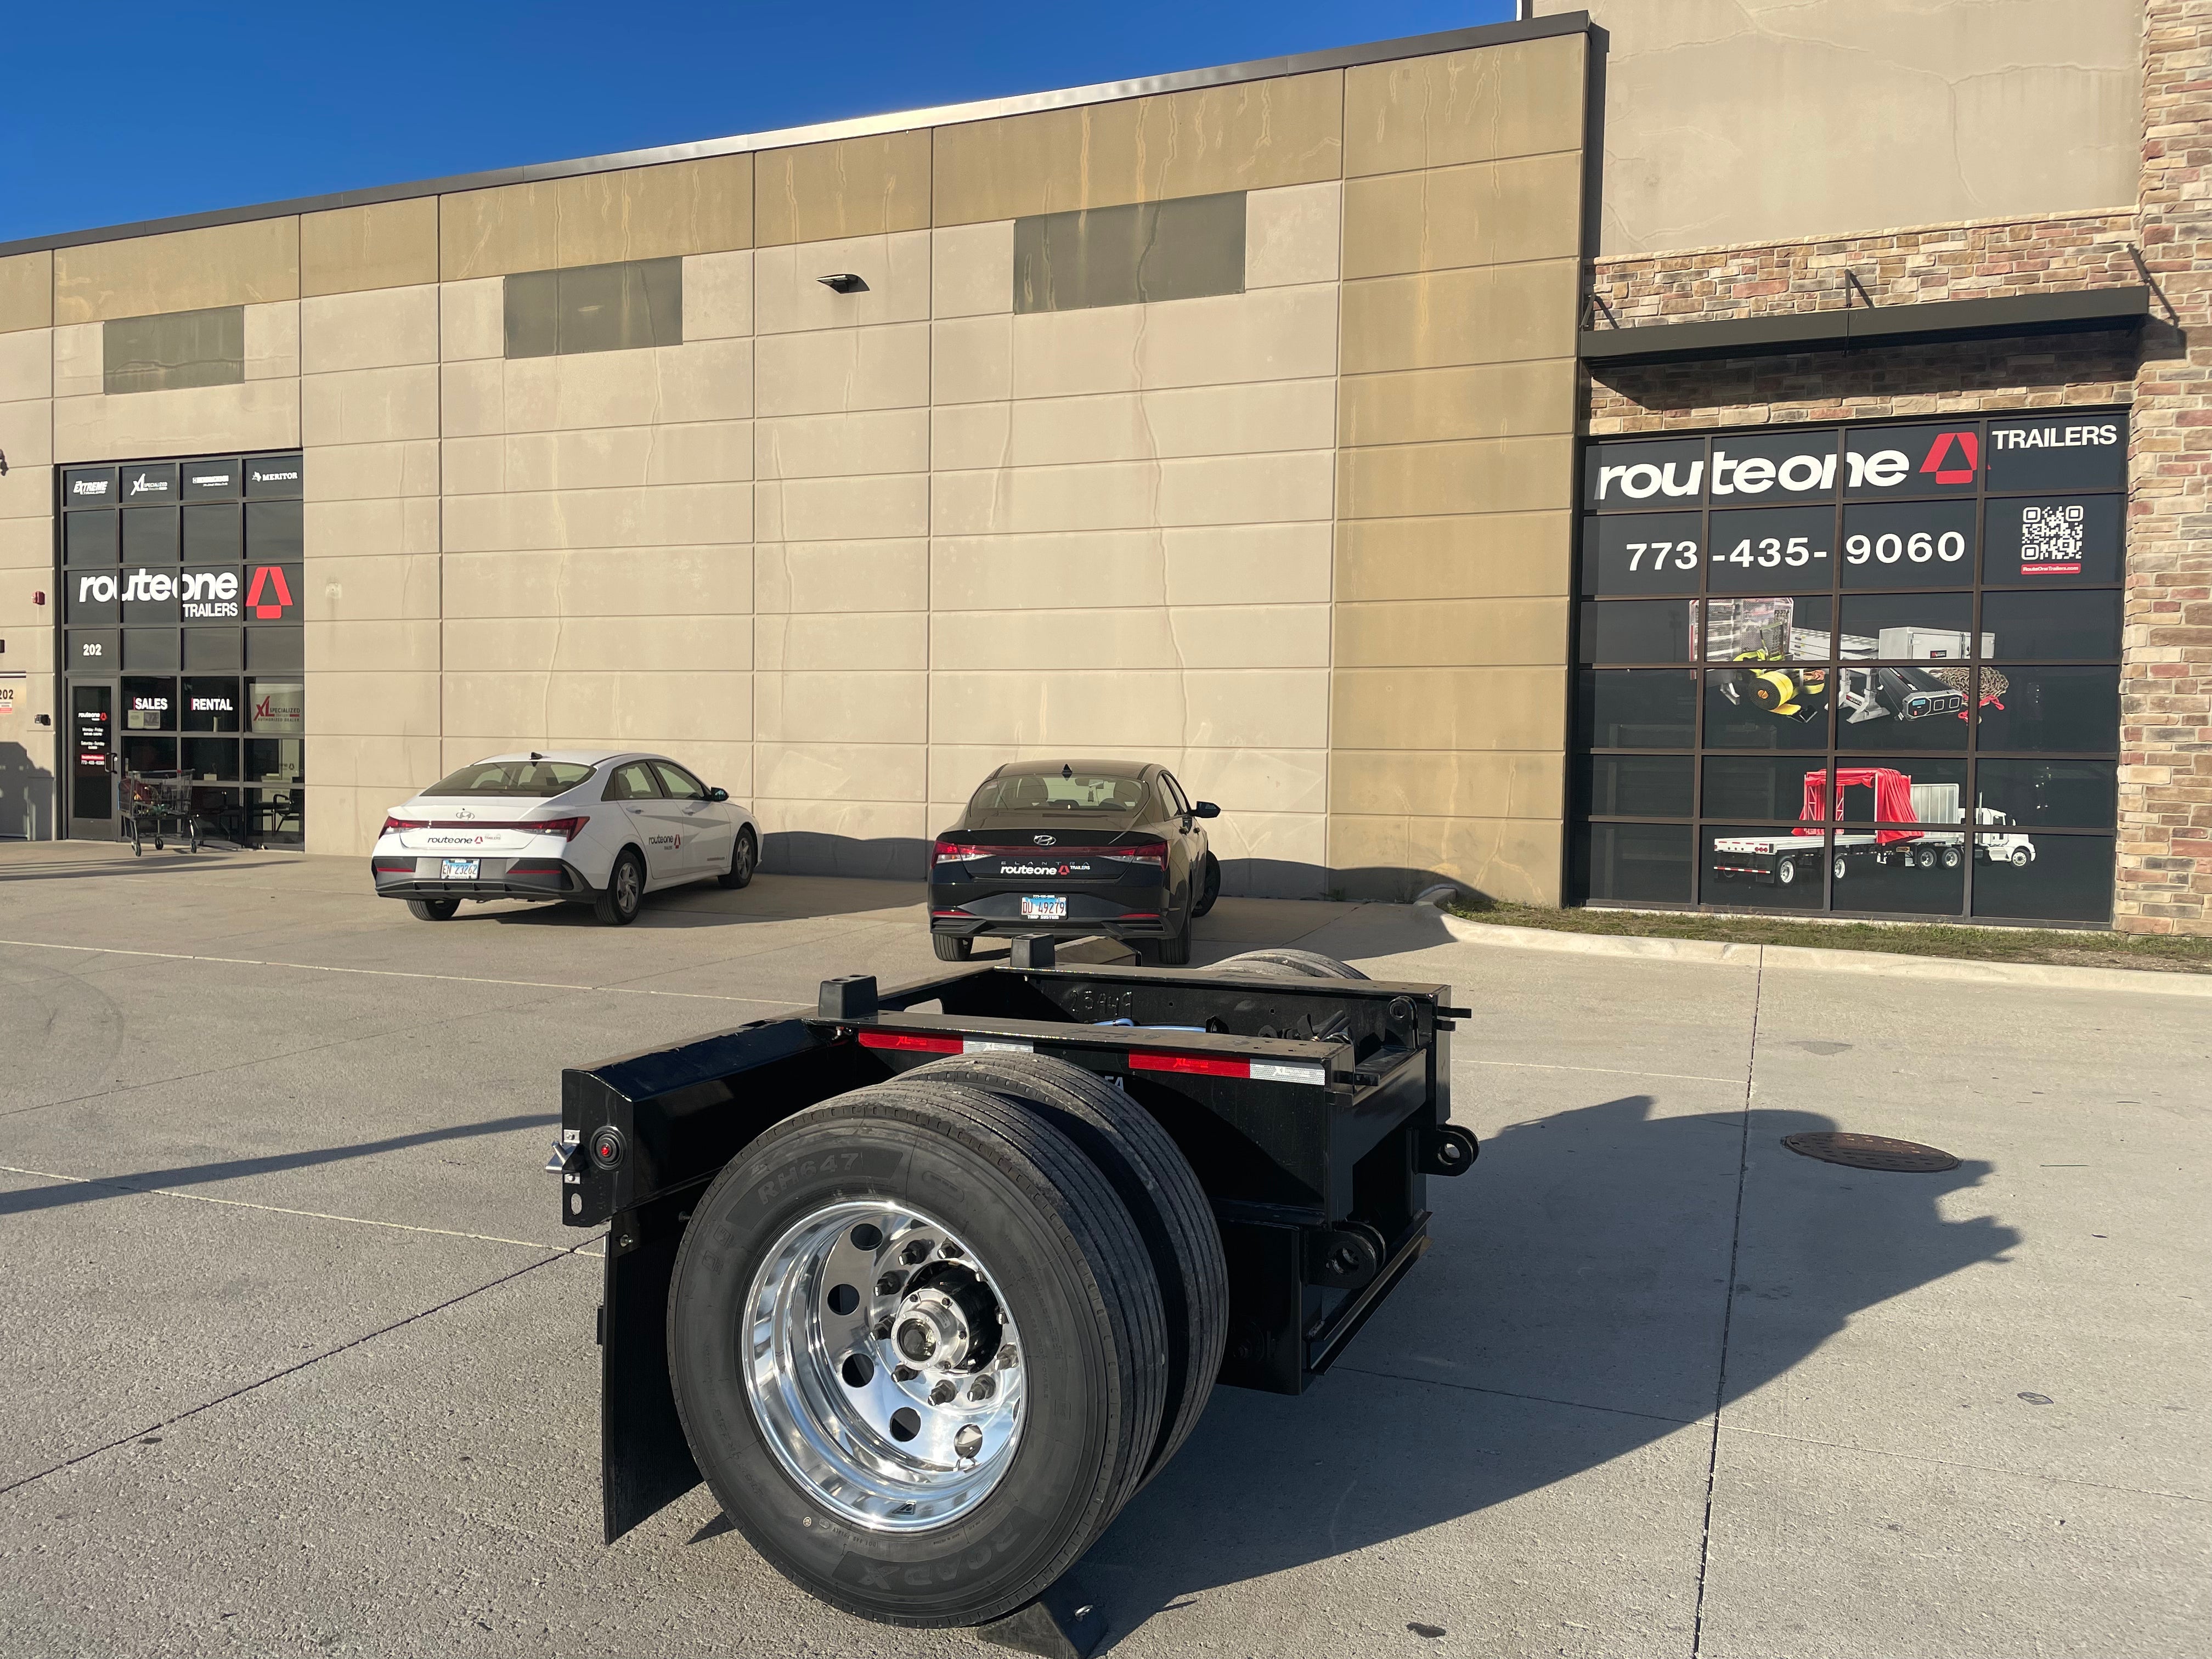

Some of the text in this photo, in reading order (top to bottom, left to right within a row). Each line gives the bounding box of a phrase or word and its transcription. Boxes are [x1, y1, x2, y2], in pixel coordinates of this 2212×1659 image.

[1992, 425, 2117, 450] TRAILERS
[263, 472, 298, 481] MERITOR
[1595, 449, 1909, 500] routeone
[73, 481, 108, 495] EXTREME
[131, 473, 148, 495] XL
[79, 568, 238, 602] routeone
[184, 603, 238, 617] TRAILERS
[83, 644, 102, 656] 202
[135, 697, 168, 710] SALES
[193, 698, 233, 710] RENTAL
[253, 696, 275, 721] XL
[648, 834, 674, 845] routeone
[442, 865, 478, 874] EN 23262
[1001, 865, 1057, 875] routeone
[1023, 902, 1065, 913] DU 49279
[757, 1152, 860, 1205] RH647
